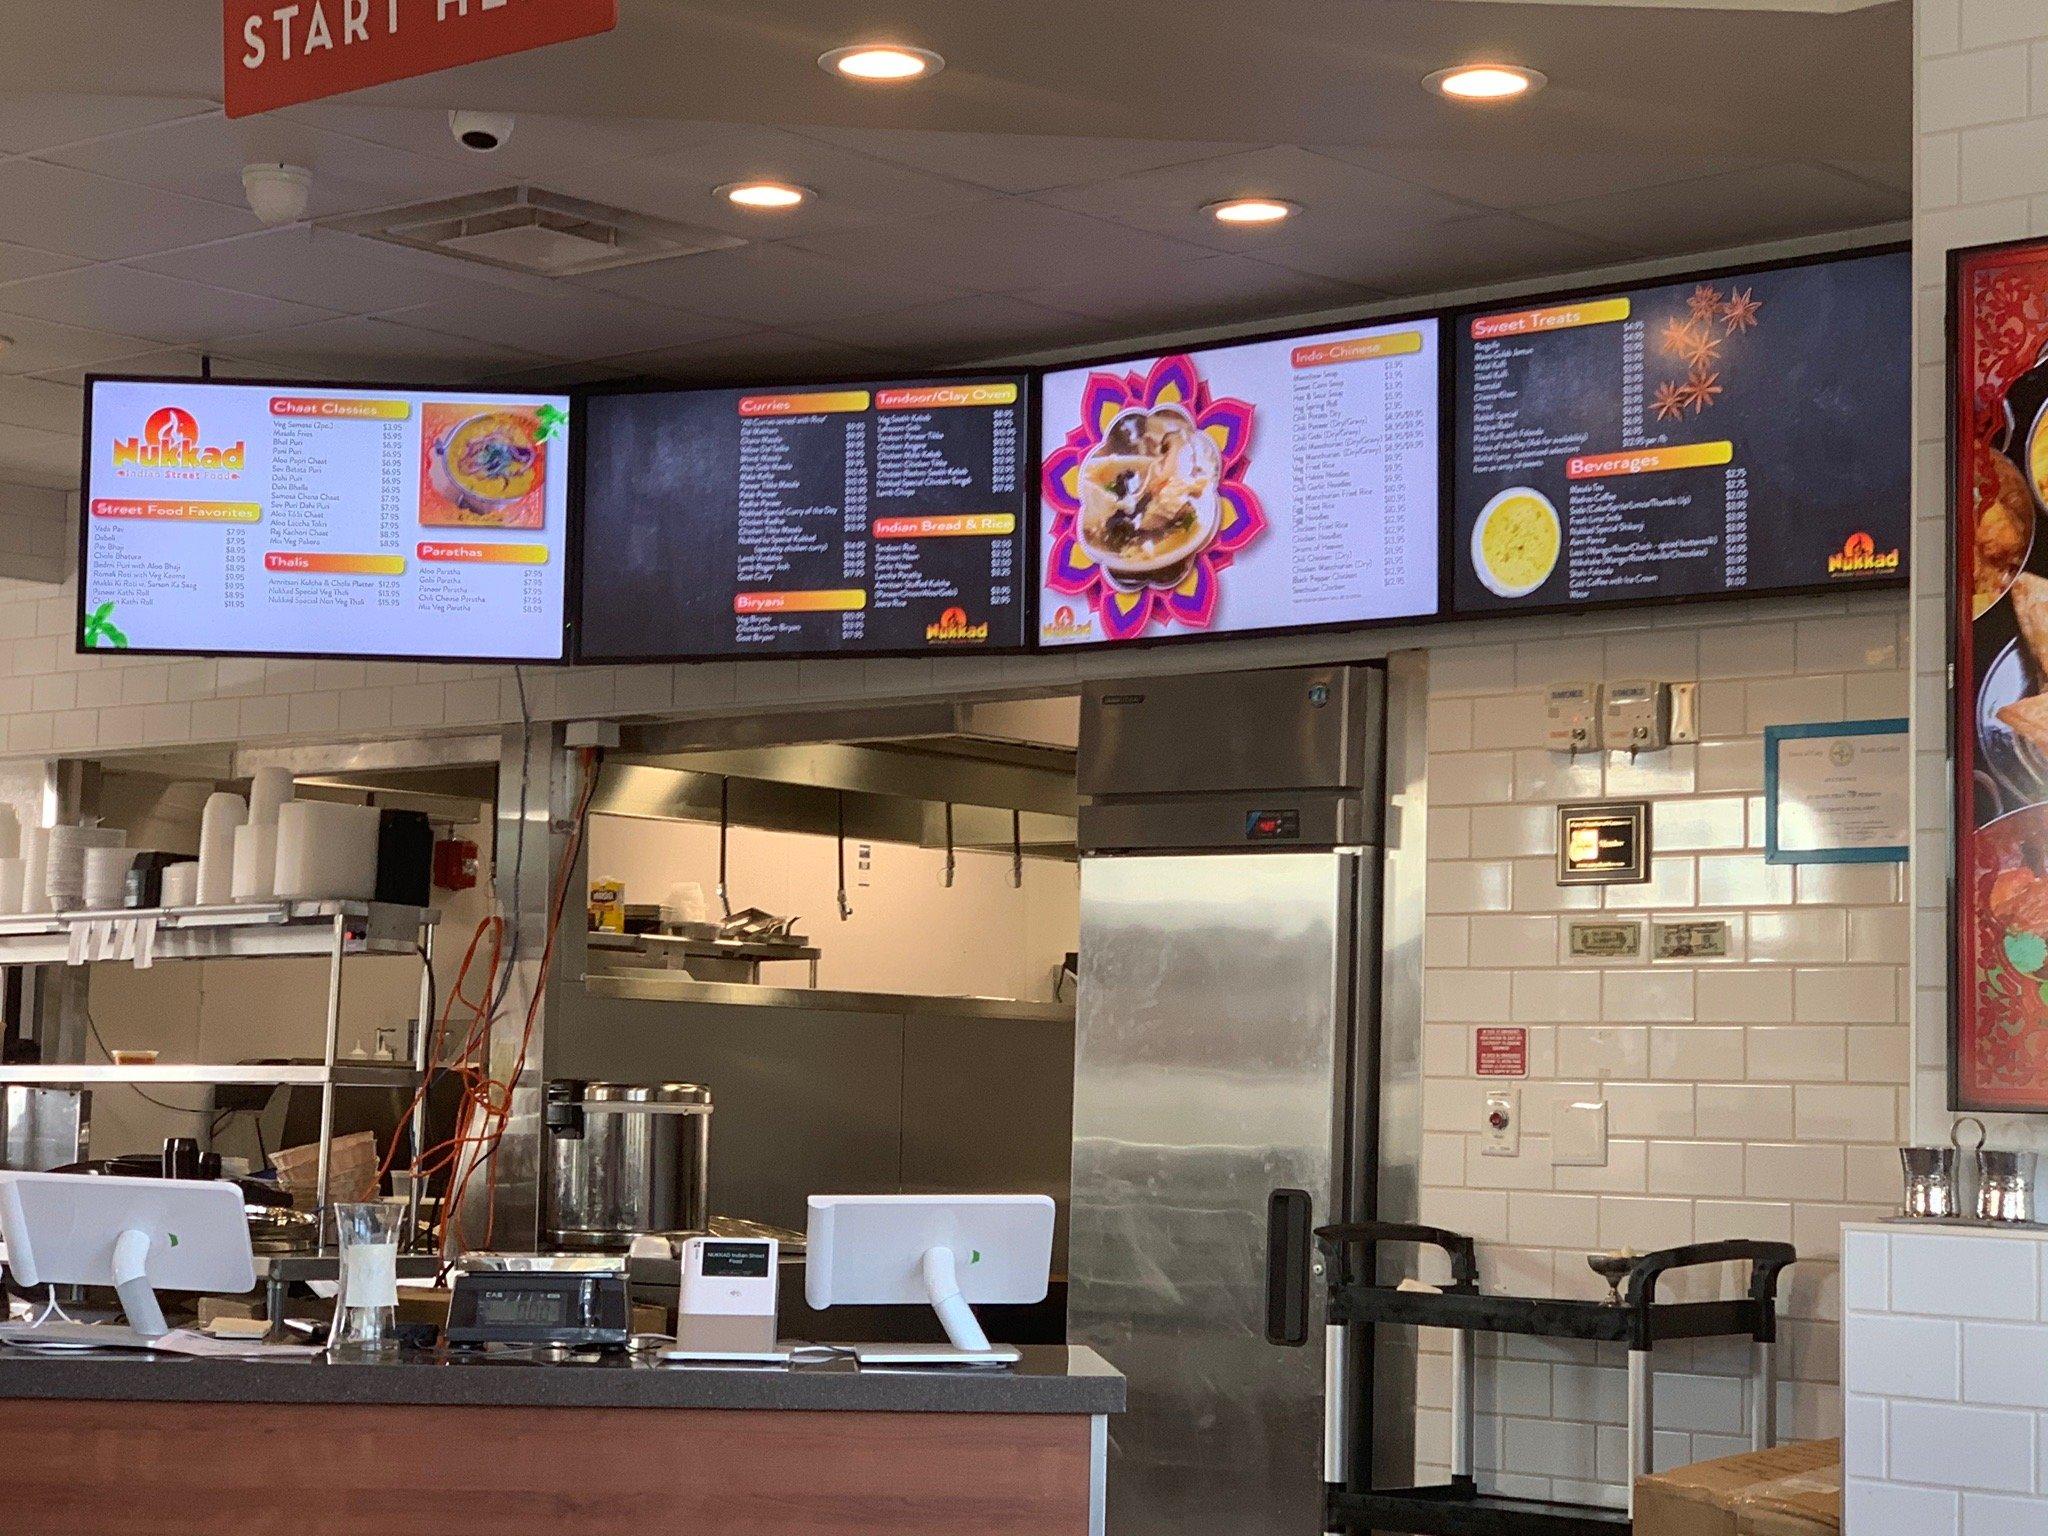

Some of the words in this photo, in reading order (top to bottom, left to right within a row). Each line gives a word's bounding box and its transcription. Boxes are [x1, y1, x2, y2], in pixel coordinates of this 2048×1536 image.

[1474, 318, 1526, 335] Sweet
[1530, 311, 1582, 327] Treats
[1296, 344, 1380, 363] Indo-Chinese
[880, 390, 969, 405] Tandoor/Clay
[973, 389, 1011, 399] Oven
[273, 401, 317, 413] Chaat
[322, 403, 377, 415] Classics
[741, 400, 791, 412] Curries
[113, 437, 244, 469] Nukkad
[1571, 455, 1660, 473] Beverages
[97, 503, 142, 515] Street
[148, 505, 183, 516] Food
[189, 506, 253, 517] Favorites
[876, 522, 917, 533] Indian
[921, 520, 961, 531] Bread
[966, 520, 976, 530] &
[982, 518, 1011, 529] Rice
[423, 545, 483, 557] Parathas
[269, 556, 309, 567] Thalis
[1828, 548, 1899, 573] Nukkad
[737, 596, 784, 611] Biryani
